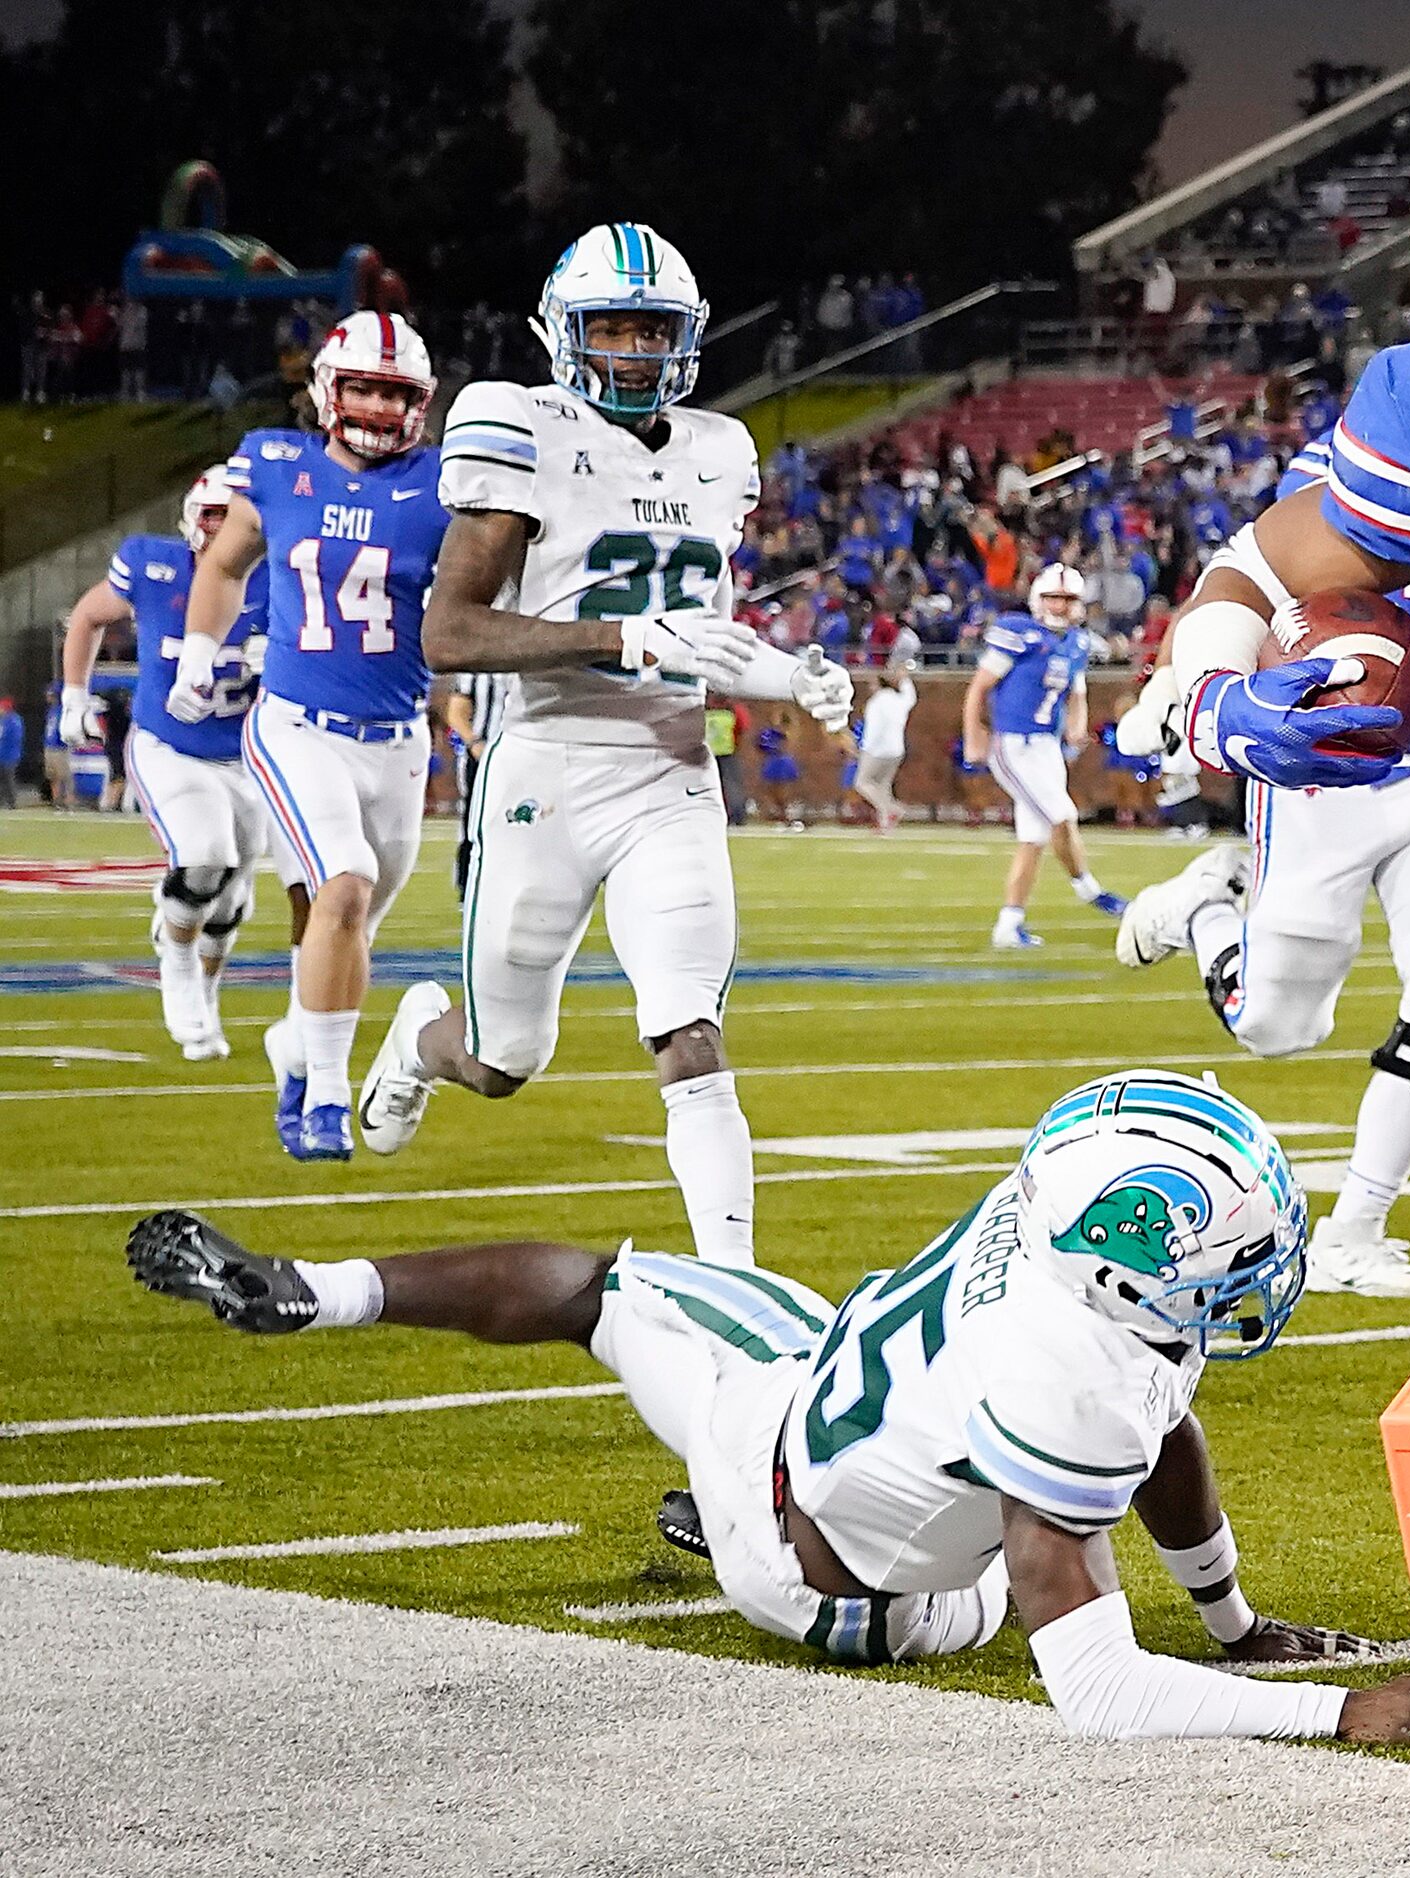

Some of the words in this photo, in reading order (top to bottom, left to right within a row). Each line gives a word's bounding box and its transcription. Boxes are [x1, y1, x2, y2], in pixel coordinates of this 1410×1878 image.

[322, 504, 372, 541] SMU
[632, 499, 691, 525] TULANE
[289, 538, 396, 654] 14
